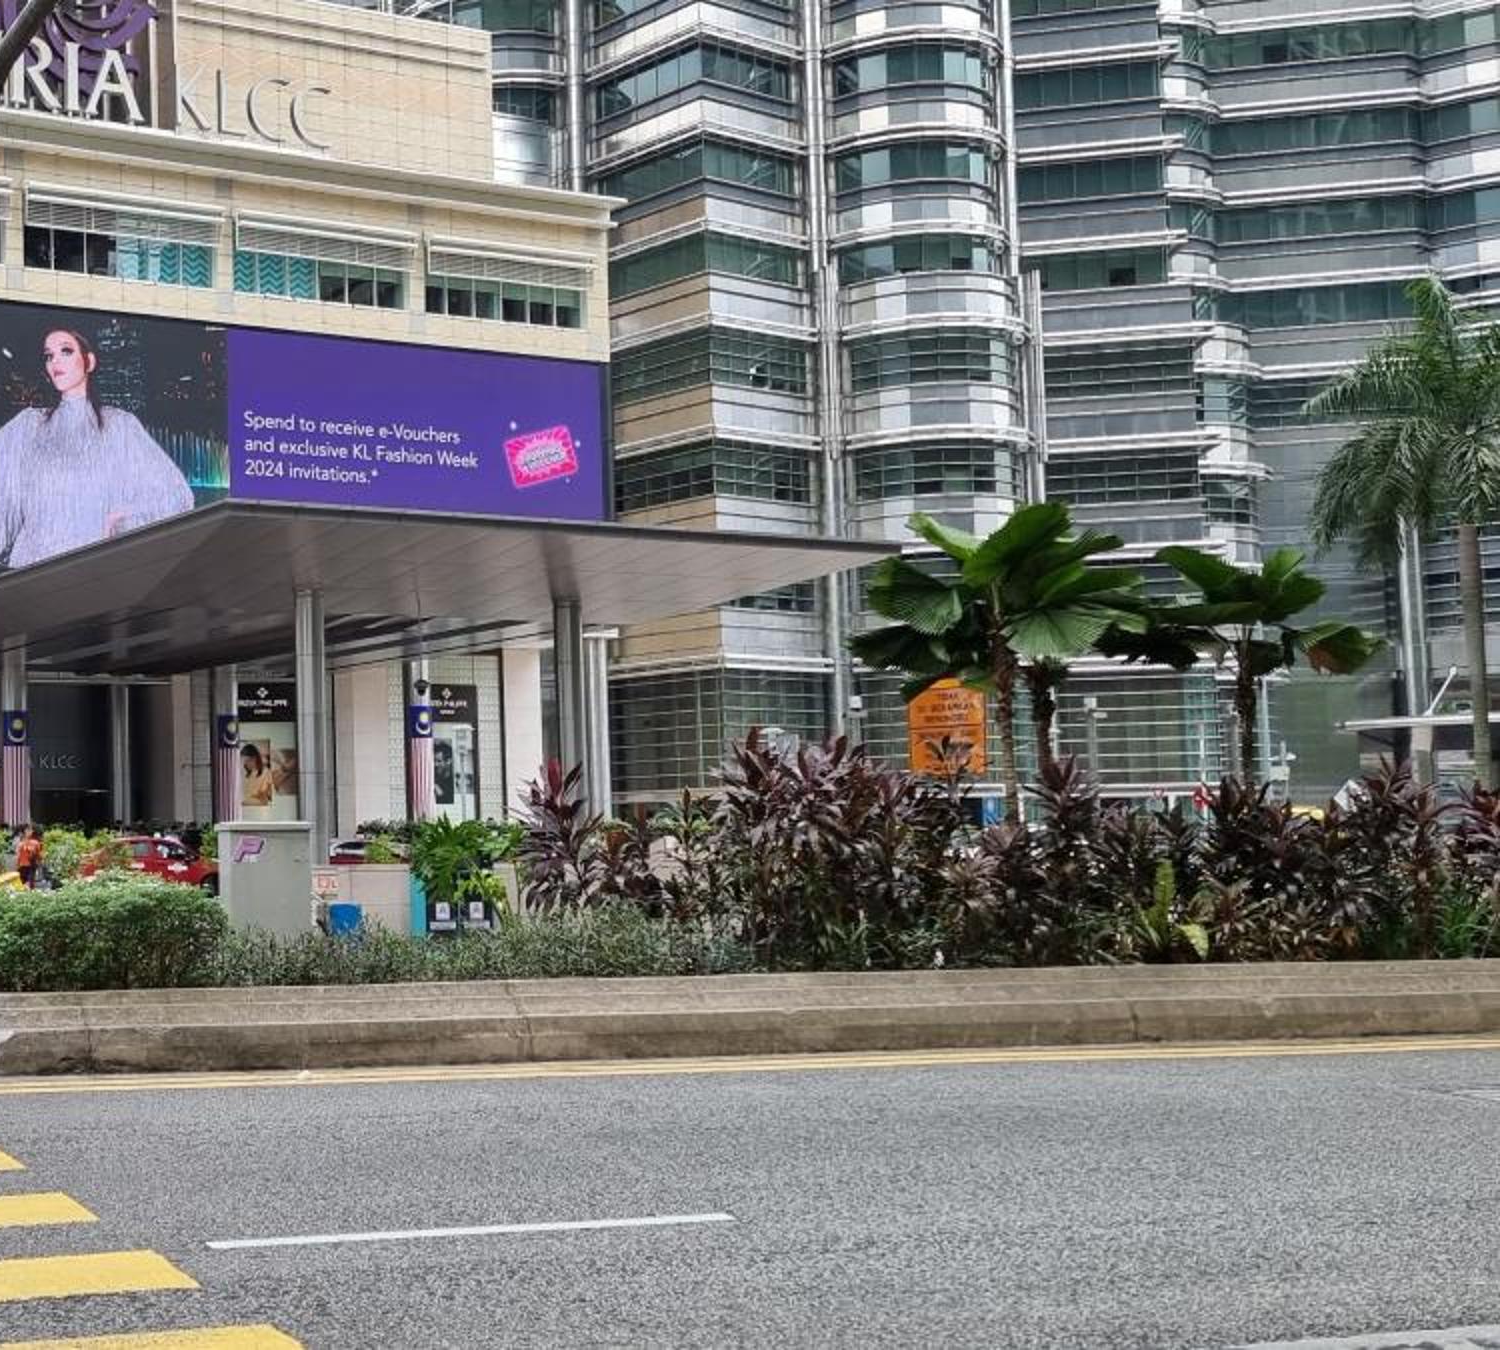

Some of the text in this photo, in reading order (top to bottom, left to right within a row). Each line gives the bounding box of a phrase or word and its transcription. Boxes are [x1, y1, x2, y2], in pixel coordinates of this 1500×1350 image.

[176, 63, 331, 150] KLCC
[243, 410, 461, 444] Spend to receive e-Vouchers
[244, 436, 479, 468] and exclusive KL Fashion Week
[244, 459, 284, 477] 2024
